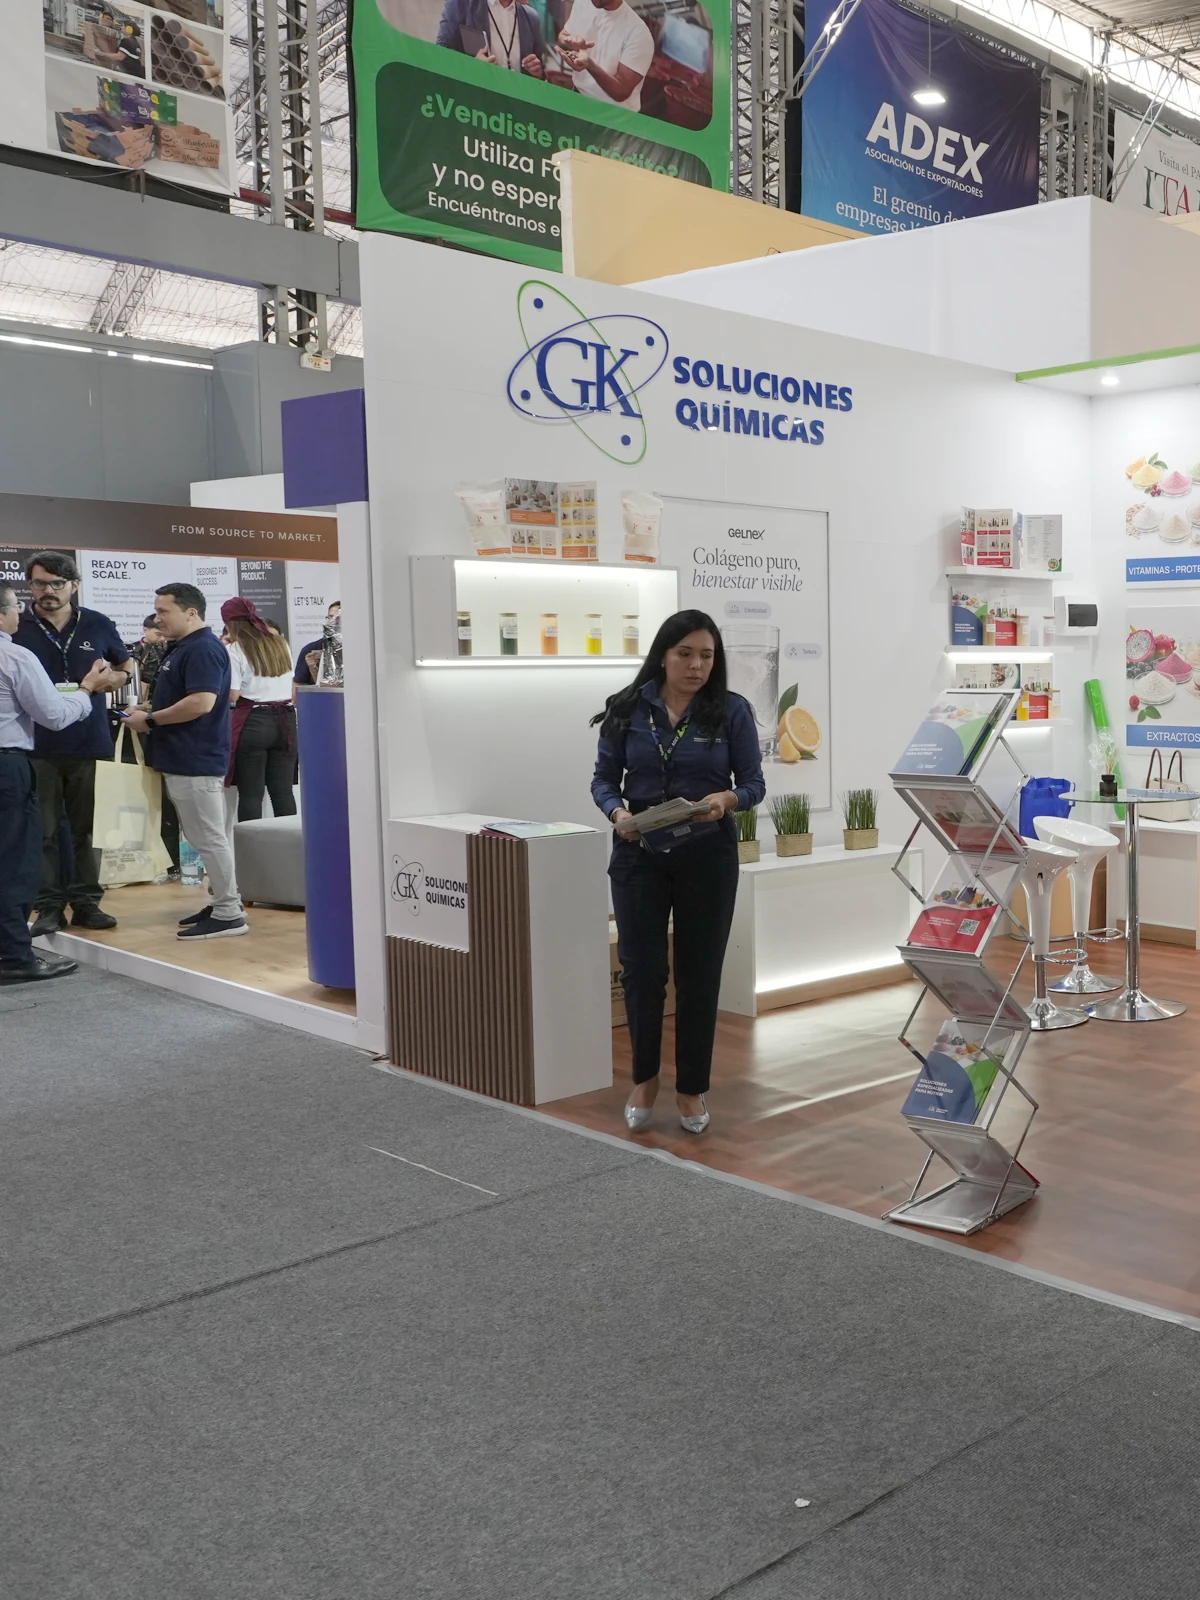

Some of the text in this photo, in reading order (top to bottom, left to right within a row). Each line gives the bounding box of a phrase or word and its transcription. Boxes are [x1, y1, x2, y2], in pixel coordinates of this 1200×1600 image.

[421, 93, 552, 148] ¿Vendiste
[866, 102, 989, 184] ADEX
[464, 136, 534, 174] Utiliza
[1159, 150, 1180, 171] Visita
[1182, 164, 1189, 175] el
[432, 162, 447, 187] y
[454, 168, 485, 191] no
[865, 147, 983, 198] ASOCIACIÓN DE EXPORTADORES
[428, 191, 546, 234] Encuéntranos
[873, 186, 887, 206] El
[891, 196, 940, 224] gremio
[836, 201, 906, 233] empresas
[535, 336, 853, 420] GK SOLUCIONES
[675, 398, 825, 445] QUÍMICAS
[171, 525, 326, 543] FROM SOURCE TO MARKET.
[2, 560, 20, 570] TO
[91, 560, 146, 570] READY TO
[196, 566, 228, 576] DESIGNED FOR
[240, 561, 272, 571] BEYOND THE
[692, 547, 801, 573] Colágeno puro,
[1128, 565, 1170, 576] VITAMINAS
[0, 571, 26, 581] ORM
[92, 570, 131, 580] SCALE.
[197, 577, 218, 586] SUCCESS.
[241, 572, 266, 581] PRODUCT.
[692, 569, 803, 592] bienestar visible
[294, 596, 309, 606] LET'S
[310, 596, 324, 606] TALK
[1146, 731, 1200, 743] EXTRACTOS
[396, 872, 468, 900] GK SOLUCIONE
[425, 891, 466, 909] QUÍMICAS
